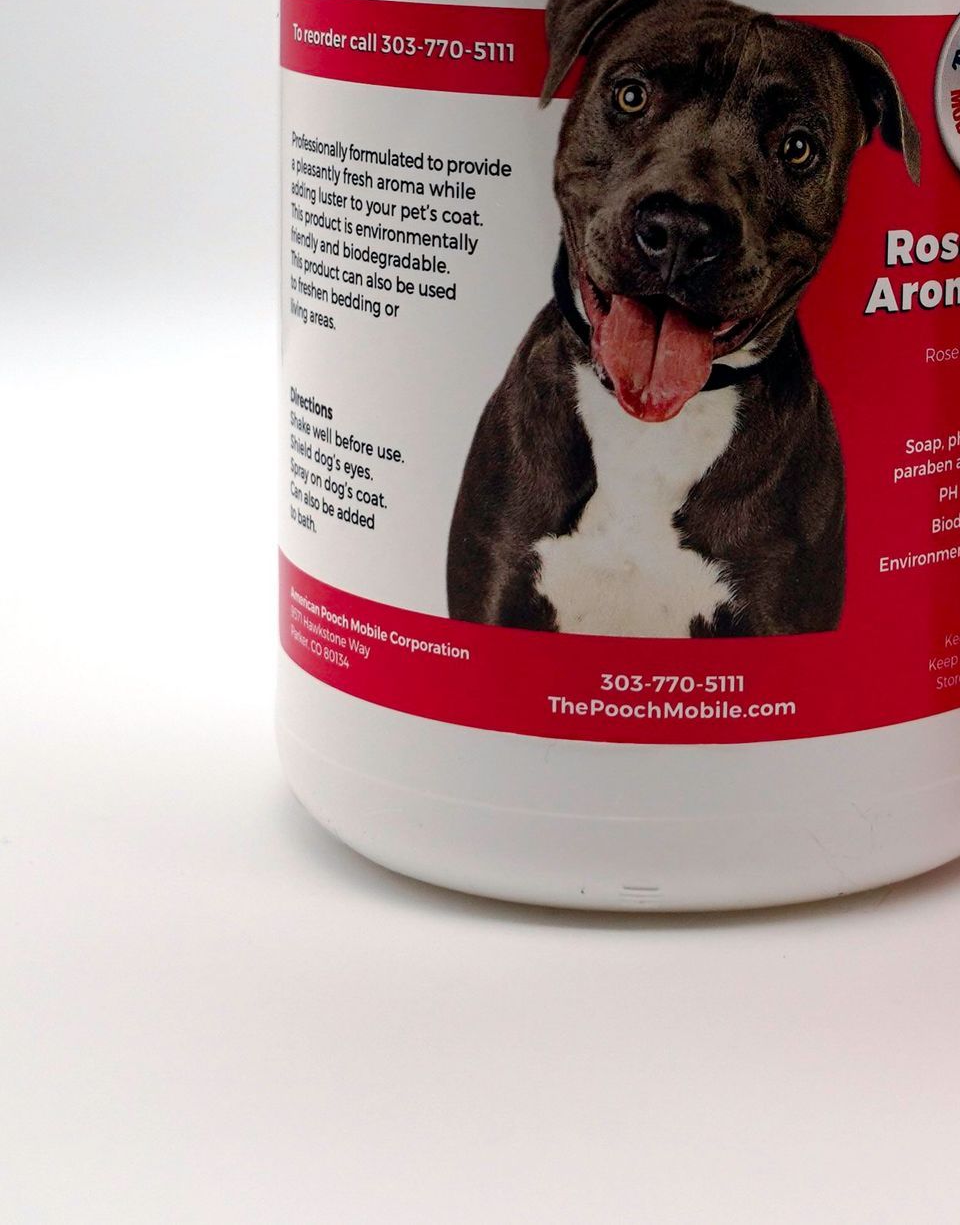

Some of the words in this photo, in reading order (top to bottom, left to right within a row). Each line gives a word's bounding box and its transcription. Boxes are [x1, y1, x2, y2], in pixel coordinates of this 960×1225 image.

[292, 23, 302, 42] To
[303, 28, 347, 48] reorder
[350, 33, 377, 52] call
[381, 35, 515, 62] 303-770-5111
[291, 131, 348, 162] Professionally
[349, 144, 424, 170] formulated
[427, 155, 443, 171] to
[447, 158, 512, 177] provide
[291, 159, 296, 171] a
[296, 157, 341, 186] pleasantly
[343, 168, 373, 188] fresh
[377, 177, 424, 196] aroma
[430, 180, 476, 200] while
[291, 181, 316, 205] adding
[318, 186, 347, 209] luster
[350, 195, 363, 211] to
[366, 200, 397, 217] your
[401, 204, 437, 222] pet's
[442, 209, 484, 227] coat.
[291, 202, 303, 221] This
[305, 212, 341, 232] product
[344, 218, 353, 234] is
[355, 222, 479, 255] environmentally
[291, 225, 318, 253] friendly
[320, 240, 340, 256] and
[343, 241, 450, 274] biodegradable.
[291, 249, 303, 269] This
[304, 258, 340, 281] product
[342, 269, 363, 286] can
[366, 272, 392, 291] also
[396, 276, 415, 294] be
[418, 283, 457, 300] used
[291, 276, 297, 290] to
[298, 277, 328, 302] freshen
[331, 290, 381, 318] bedding
[384, 303, 400, 318] or
[291, 298, 308, 324] living
[309, 310, 336, 331] areas.
[290, 386, 333, 420] Directions
[290, 411, 311, 435] Shake
[313, 426, 332, 444] well
[335, 430, 374, 456] before
[377, 446, 405, 464] use.
[290, 434, 312, 459] Shield
[314, 448, 341, 472] dog's
[344, 461, 373, 481] eyes.
[905, 437, 944, 455] Soap,
[290, 457, 309, 485] Spray
[310, 473, 322, 488] on
[324, 477, 353, 500] dog's
[356, 490, 387, 509] coat.
[893, 459, 953, 483] paraben
[290, 480, 302, 503] Can
[304, 490, 320, 510] also
[322, 497, 335, 517] be
[337, 507, 375, 530] added
[939, 485, 958, 503] PH
[290, 586, 320, 615] American
[320, 606, 349, 629] Pooch
[351, 617, 387, 641] Mobile
[389, 631, 470, 660] Corporation
[303, 615, 347, 648] Hawkstone
[349, 638, 371, 660] Way
[310, 639, 323, 657] CO
[323, 647, 350, 670] 80134
[928, 656, 958, 672] Keep
[600, 673, 745, 693] 303-770-5111
[547, 695, 797, 719] ThePoochMobile.com
